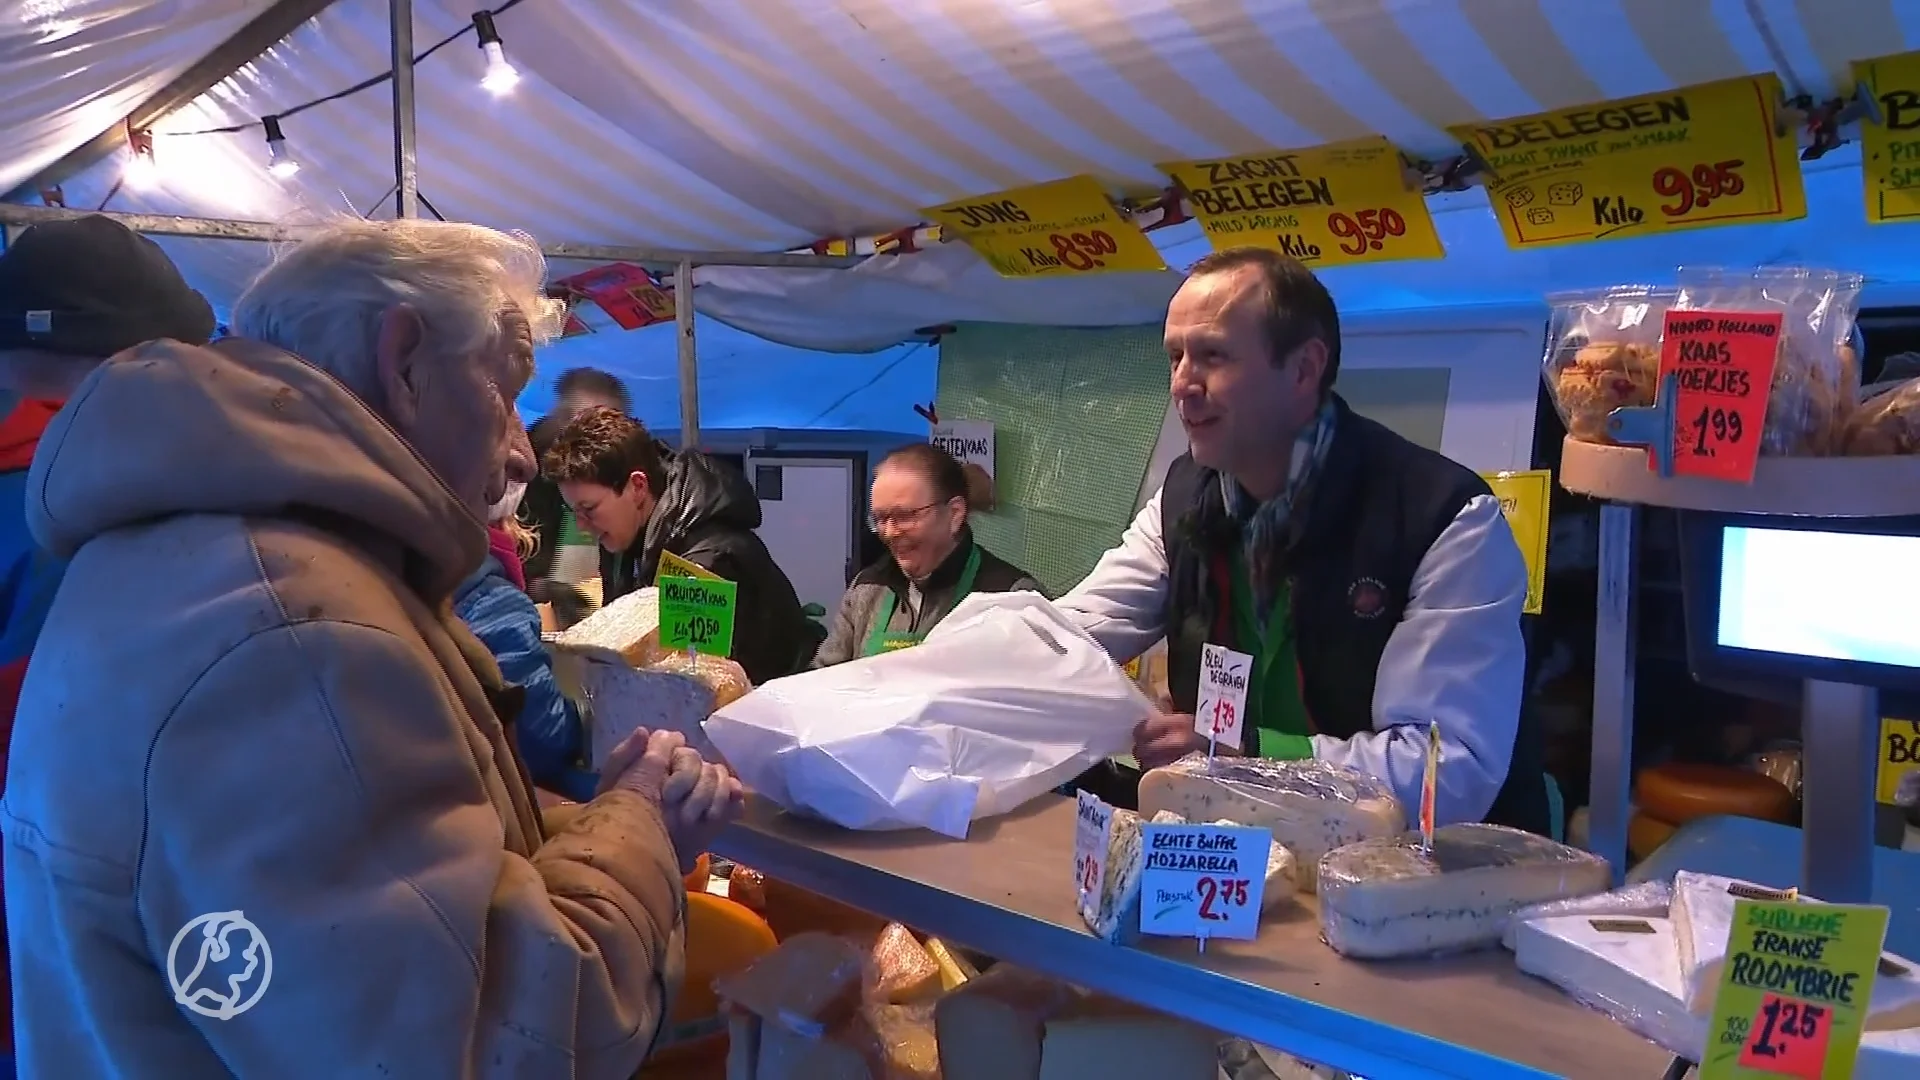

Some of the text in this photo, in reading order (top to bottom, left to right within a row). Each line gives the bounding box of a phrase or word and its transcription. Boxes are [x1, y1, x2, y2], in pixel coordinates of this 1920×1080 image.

[1478, 96, 1691, 149] BELEGEN
[1195, 155, 1301, 185] ZACHT
[1191, 177, 1334, 215] BELEGEN
[1653, 160, 1745, 216] 9.95
[941, 199, 1031, 228] JONG
[1593, 195, 1645, 227] Kilo
[1278, 234, 1321, 256] Kilo
[1328, 208, 1406, 256] 9.50
[1019, 247, 1061, 267] Kilo
[1049, 230, 1117, 271] 8.90
[1668, 318, 1776, 338] NOORD HOLLAND
[1678, 339, 1731, 364] KAAS
[1692, 404, 1743, 457] 1.99
[1152, 832, 1195, 849] ECHTE
[1145, 852, 1239, 873] MOZZARELLA
[1197, 876, 1250, 921] 2.75
[1752, 930, 1829, 960] FRANSE
[1731, 952, 1860, 1003] ROOMBRIE
[1751, 997, 1825, 1058] 1.25
